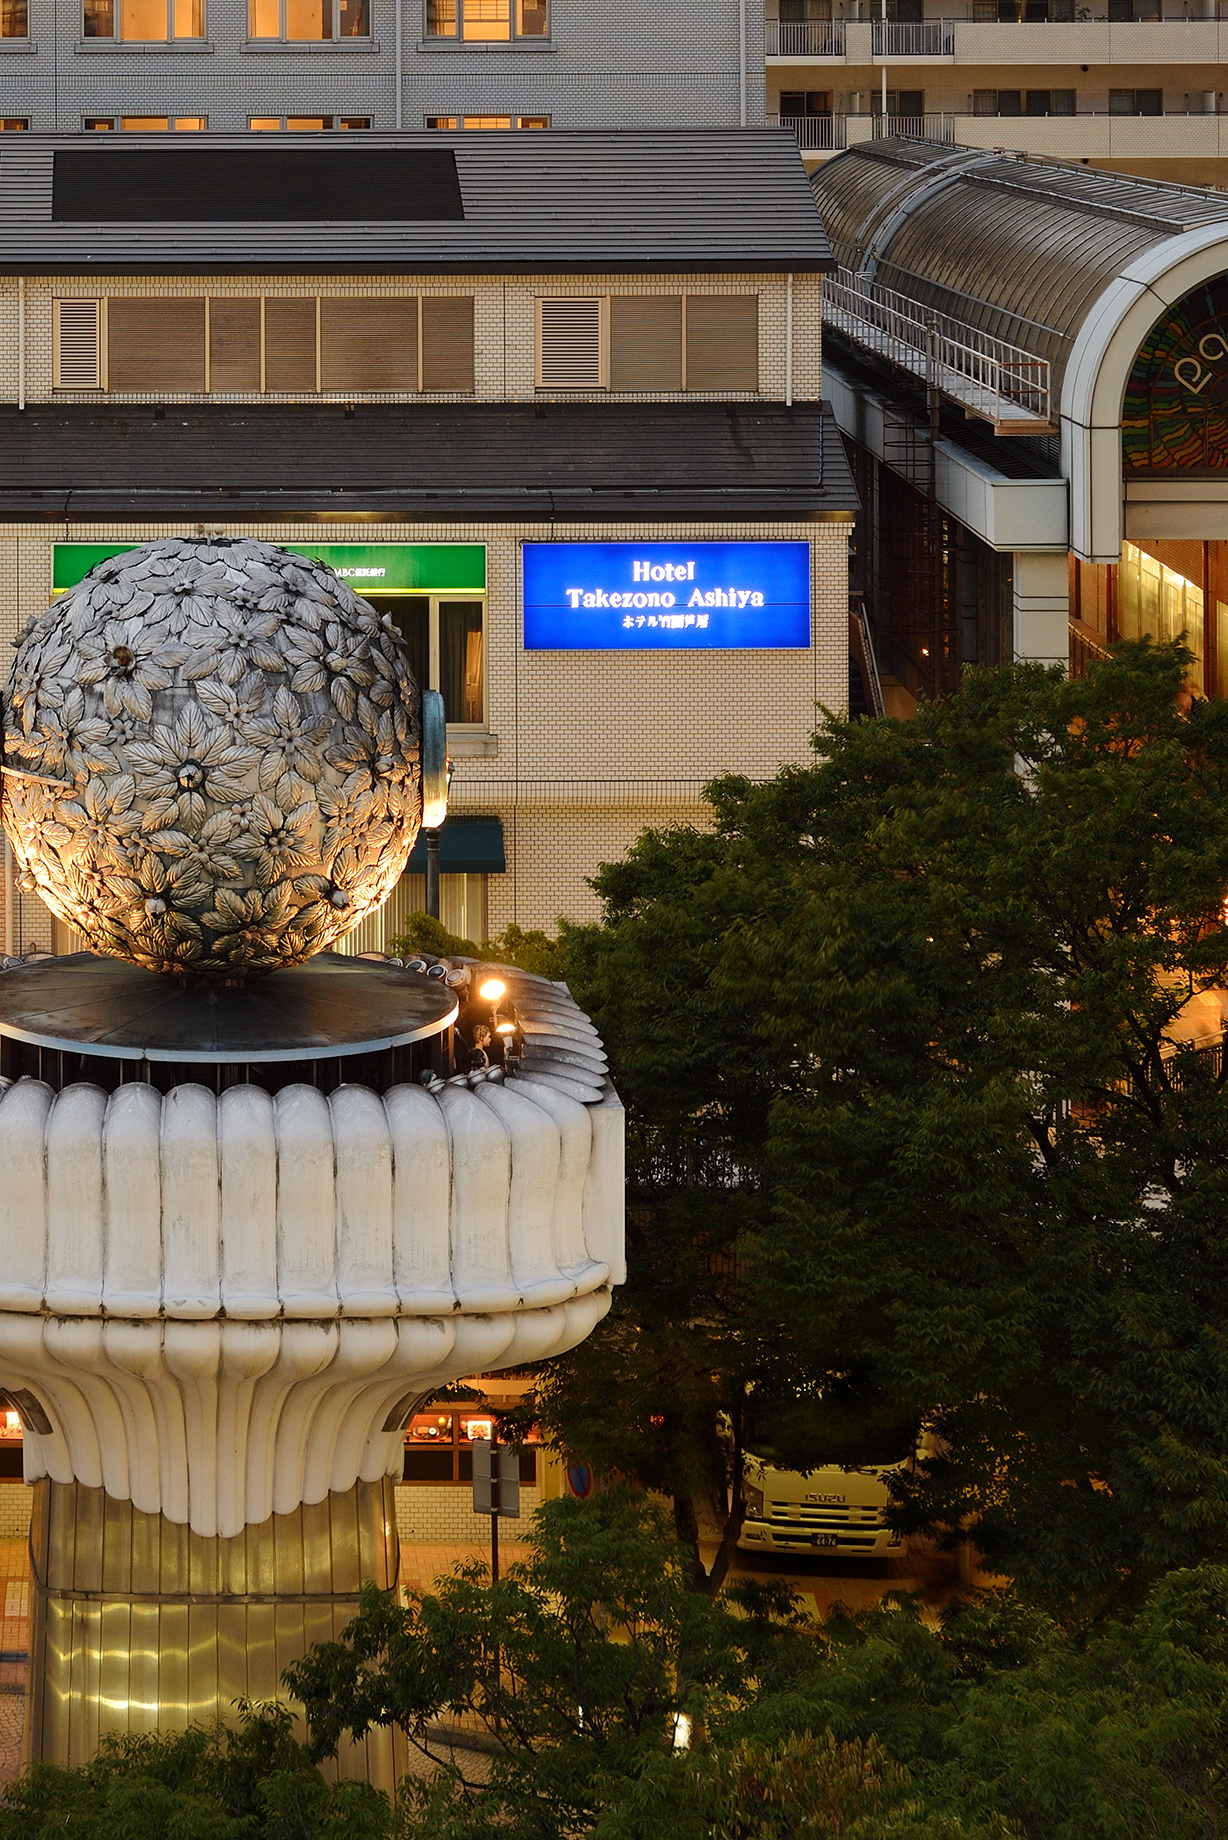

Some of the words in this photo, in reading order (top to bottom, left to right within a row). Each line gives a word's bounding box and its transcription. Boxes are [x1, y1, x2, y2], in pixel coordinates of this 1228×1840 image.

[633, 561, 696, 582] Hotel
[566, 588, 676, 609] Takezono
[687, 587, 765, 609] Ashiya
[805, 1492, 846, 1503] ISUZU
